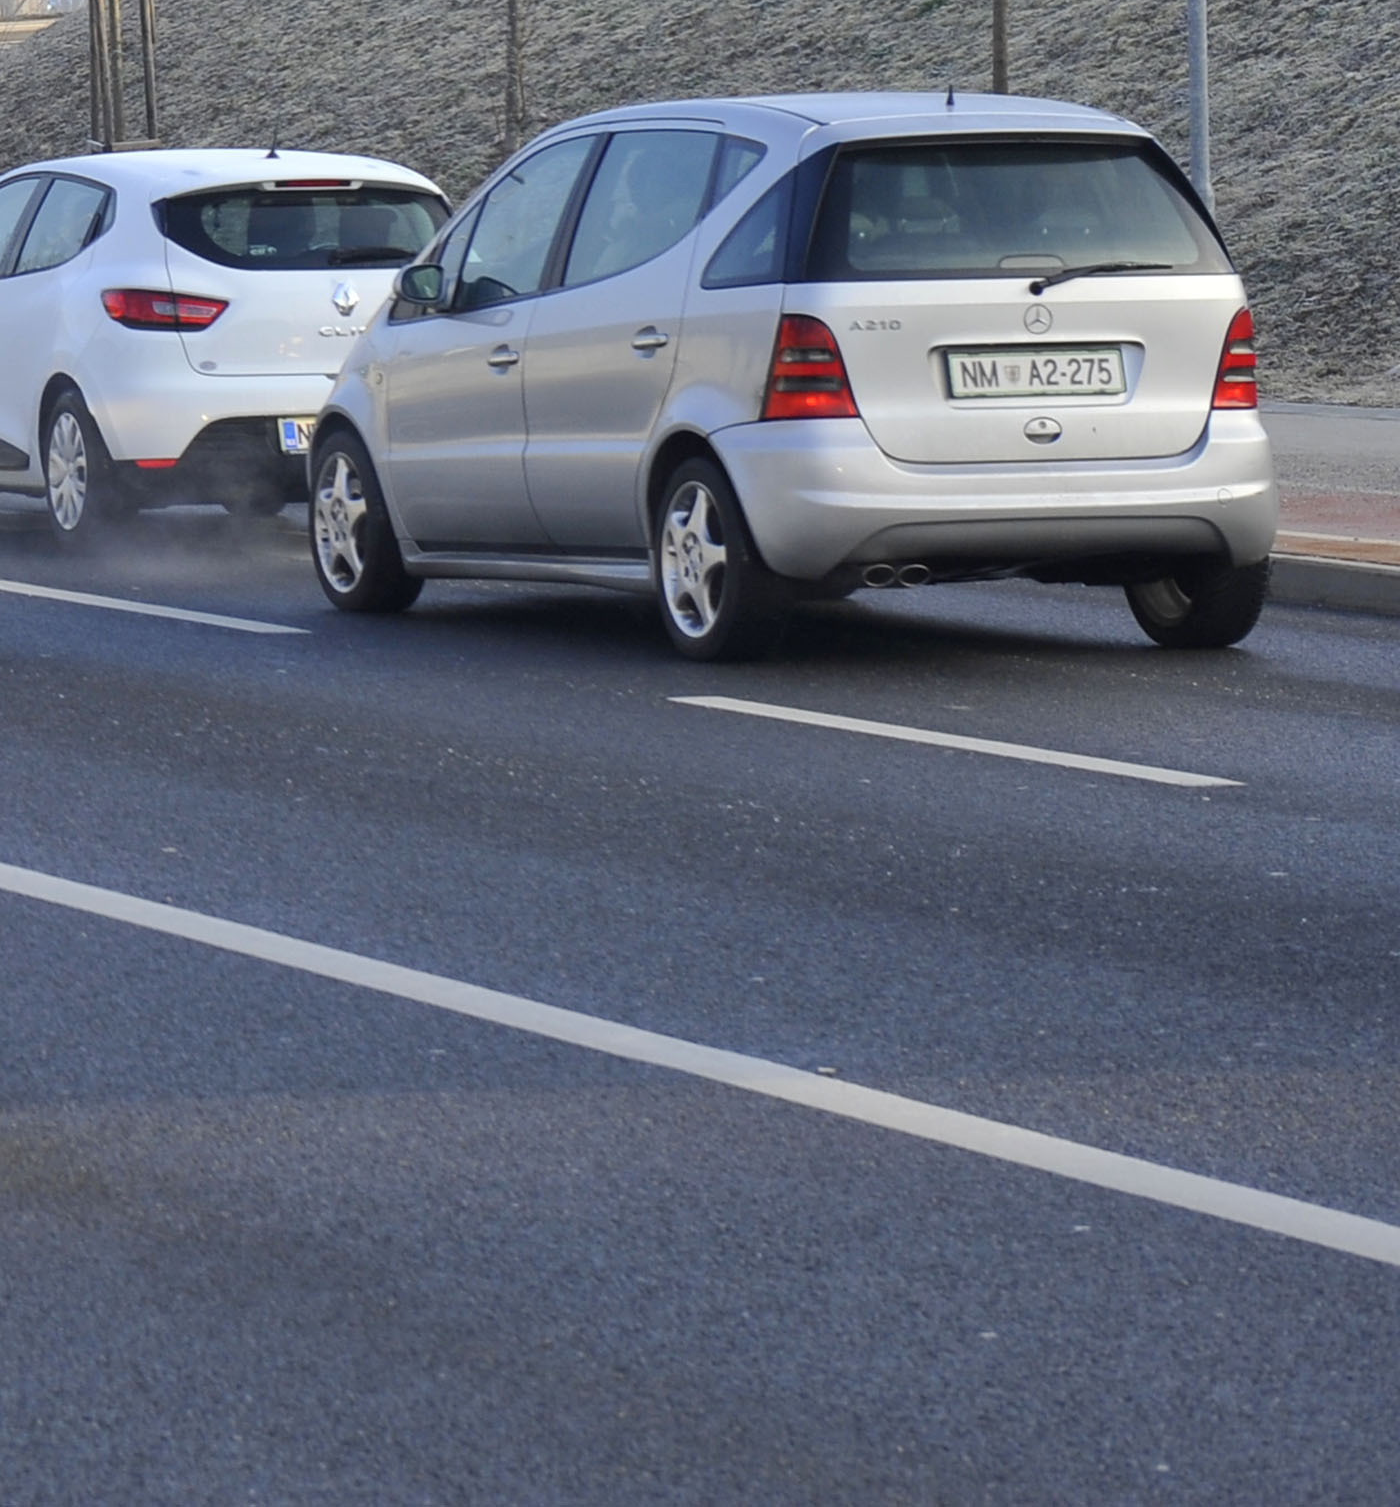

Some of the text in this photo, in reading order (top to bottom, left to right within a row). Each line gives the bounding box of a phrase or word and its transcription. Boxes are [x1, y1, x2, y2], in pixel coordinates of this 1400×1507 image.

[849, 320, 902, 331] A210
[960, 358, 1113, 389] NM A2-275
